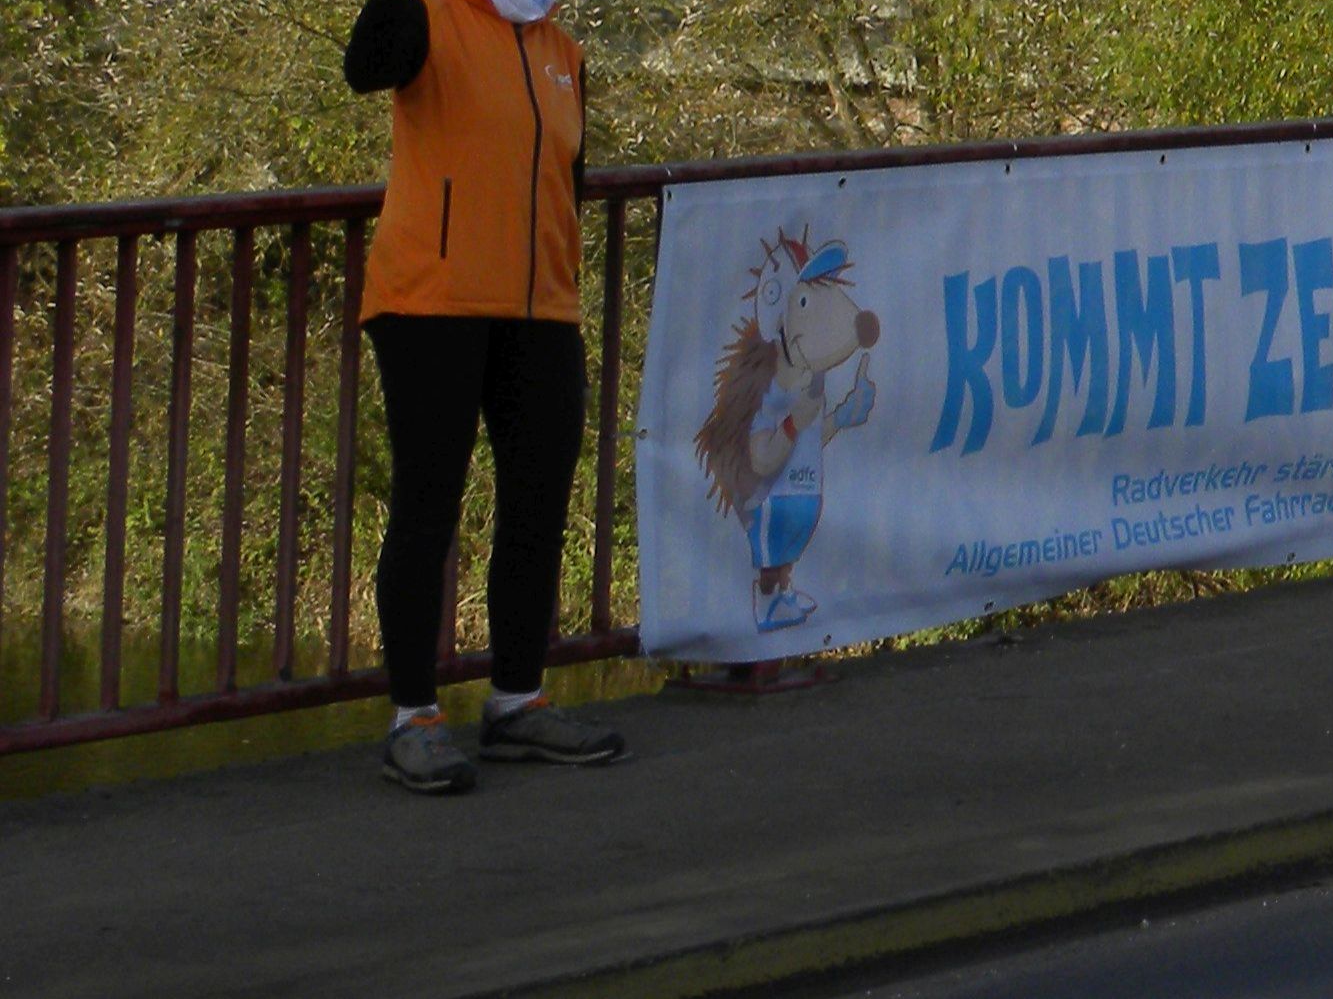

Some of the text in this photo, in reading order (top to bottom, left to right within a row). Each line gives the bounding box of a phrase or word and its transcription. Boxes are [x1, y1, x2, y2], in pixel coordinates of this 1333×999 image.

[929, 241, 1221, 456] KOMMT
[1111, 462, 1267, 507] Radverkehr
[945, 530, 1103, 577] Allgemeiner
[1111, 507, 1236, 557] Deutscher
